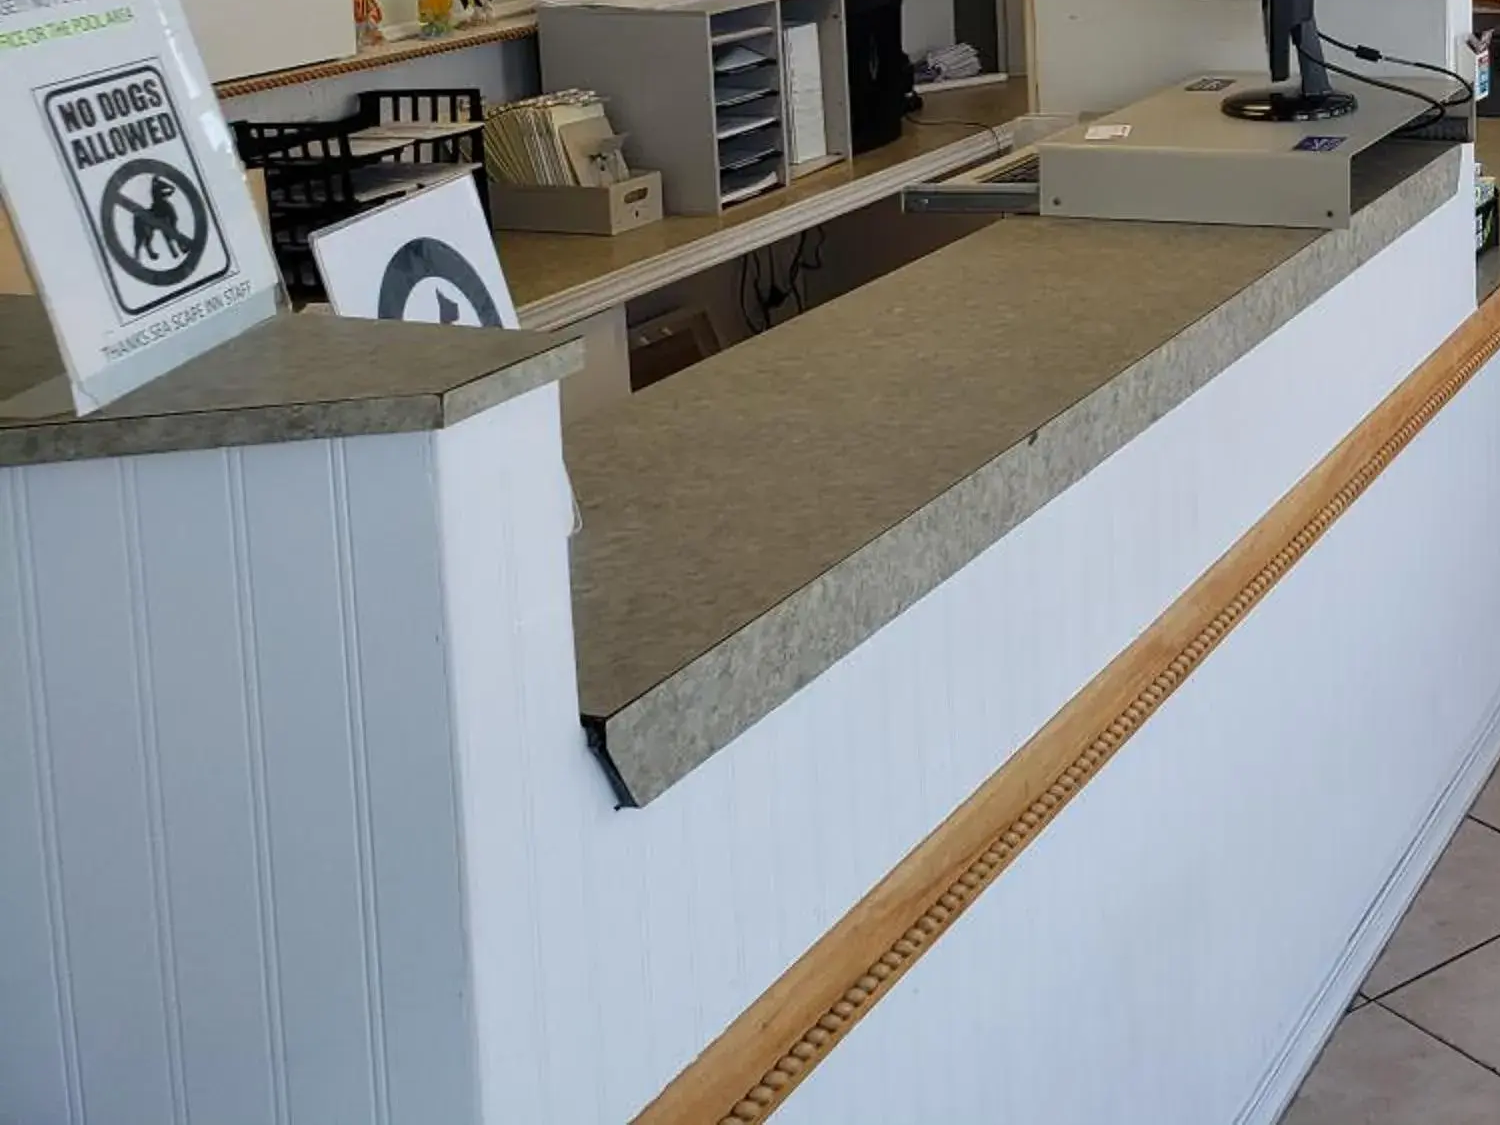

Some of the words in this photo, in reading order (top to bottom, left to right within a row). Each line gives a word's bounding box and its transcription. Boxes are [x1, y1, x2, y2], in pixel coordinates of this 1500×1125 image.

[71, 13, 107, 32] POOL
[57, 97, 96, 133] NO
[96, 79, 163, 121] DOGS
[71, 113, 177, 169] ALLOWED
[100, 328, 150, 362] THANKS
[150, 320, 172, 342] SEA
[171, 303, 205, 330] SCAPE
